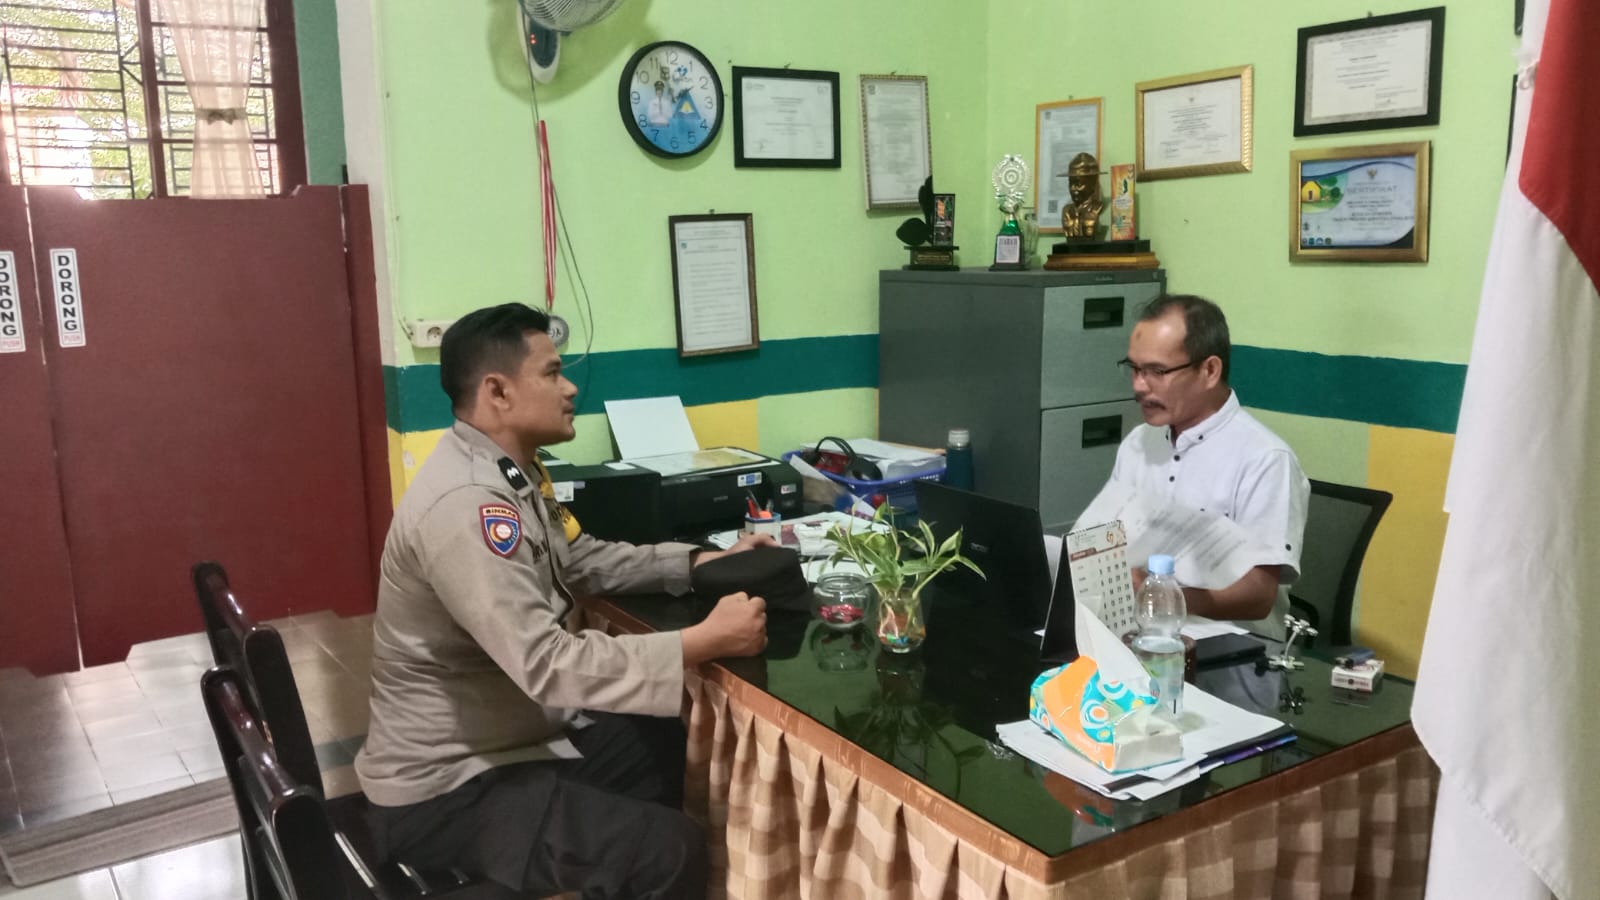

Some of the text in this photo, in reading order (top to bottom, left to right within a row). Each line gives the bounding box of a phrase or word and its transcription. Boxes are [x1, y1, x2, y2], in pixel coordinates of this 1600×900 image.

[649, 57, 658, 70] 11
[666, 50, 678, 65] 12
[636, 70, 649, 84] 10
[699, 76, 708, 89] 2
[631, 91, 640, 104] 9
[704, 96, 713, 109] 3
[639, 114, 648, 128] 8
[700, 119, 708, 130] 4
[651, 129, 659, 141] 7
[688, 132, 697, 144] 5
[670, 137, 679, 149] 6
[58, 256, 78, 331] DORONG
